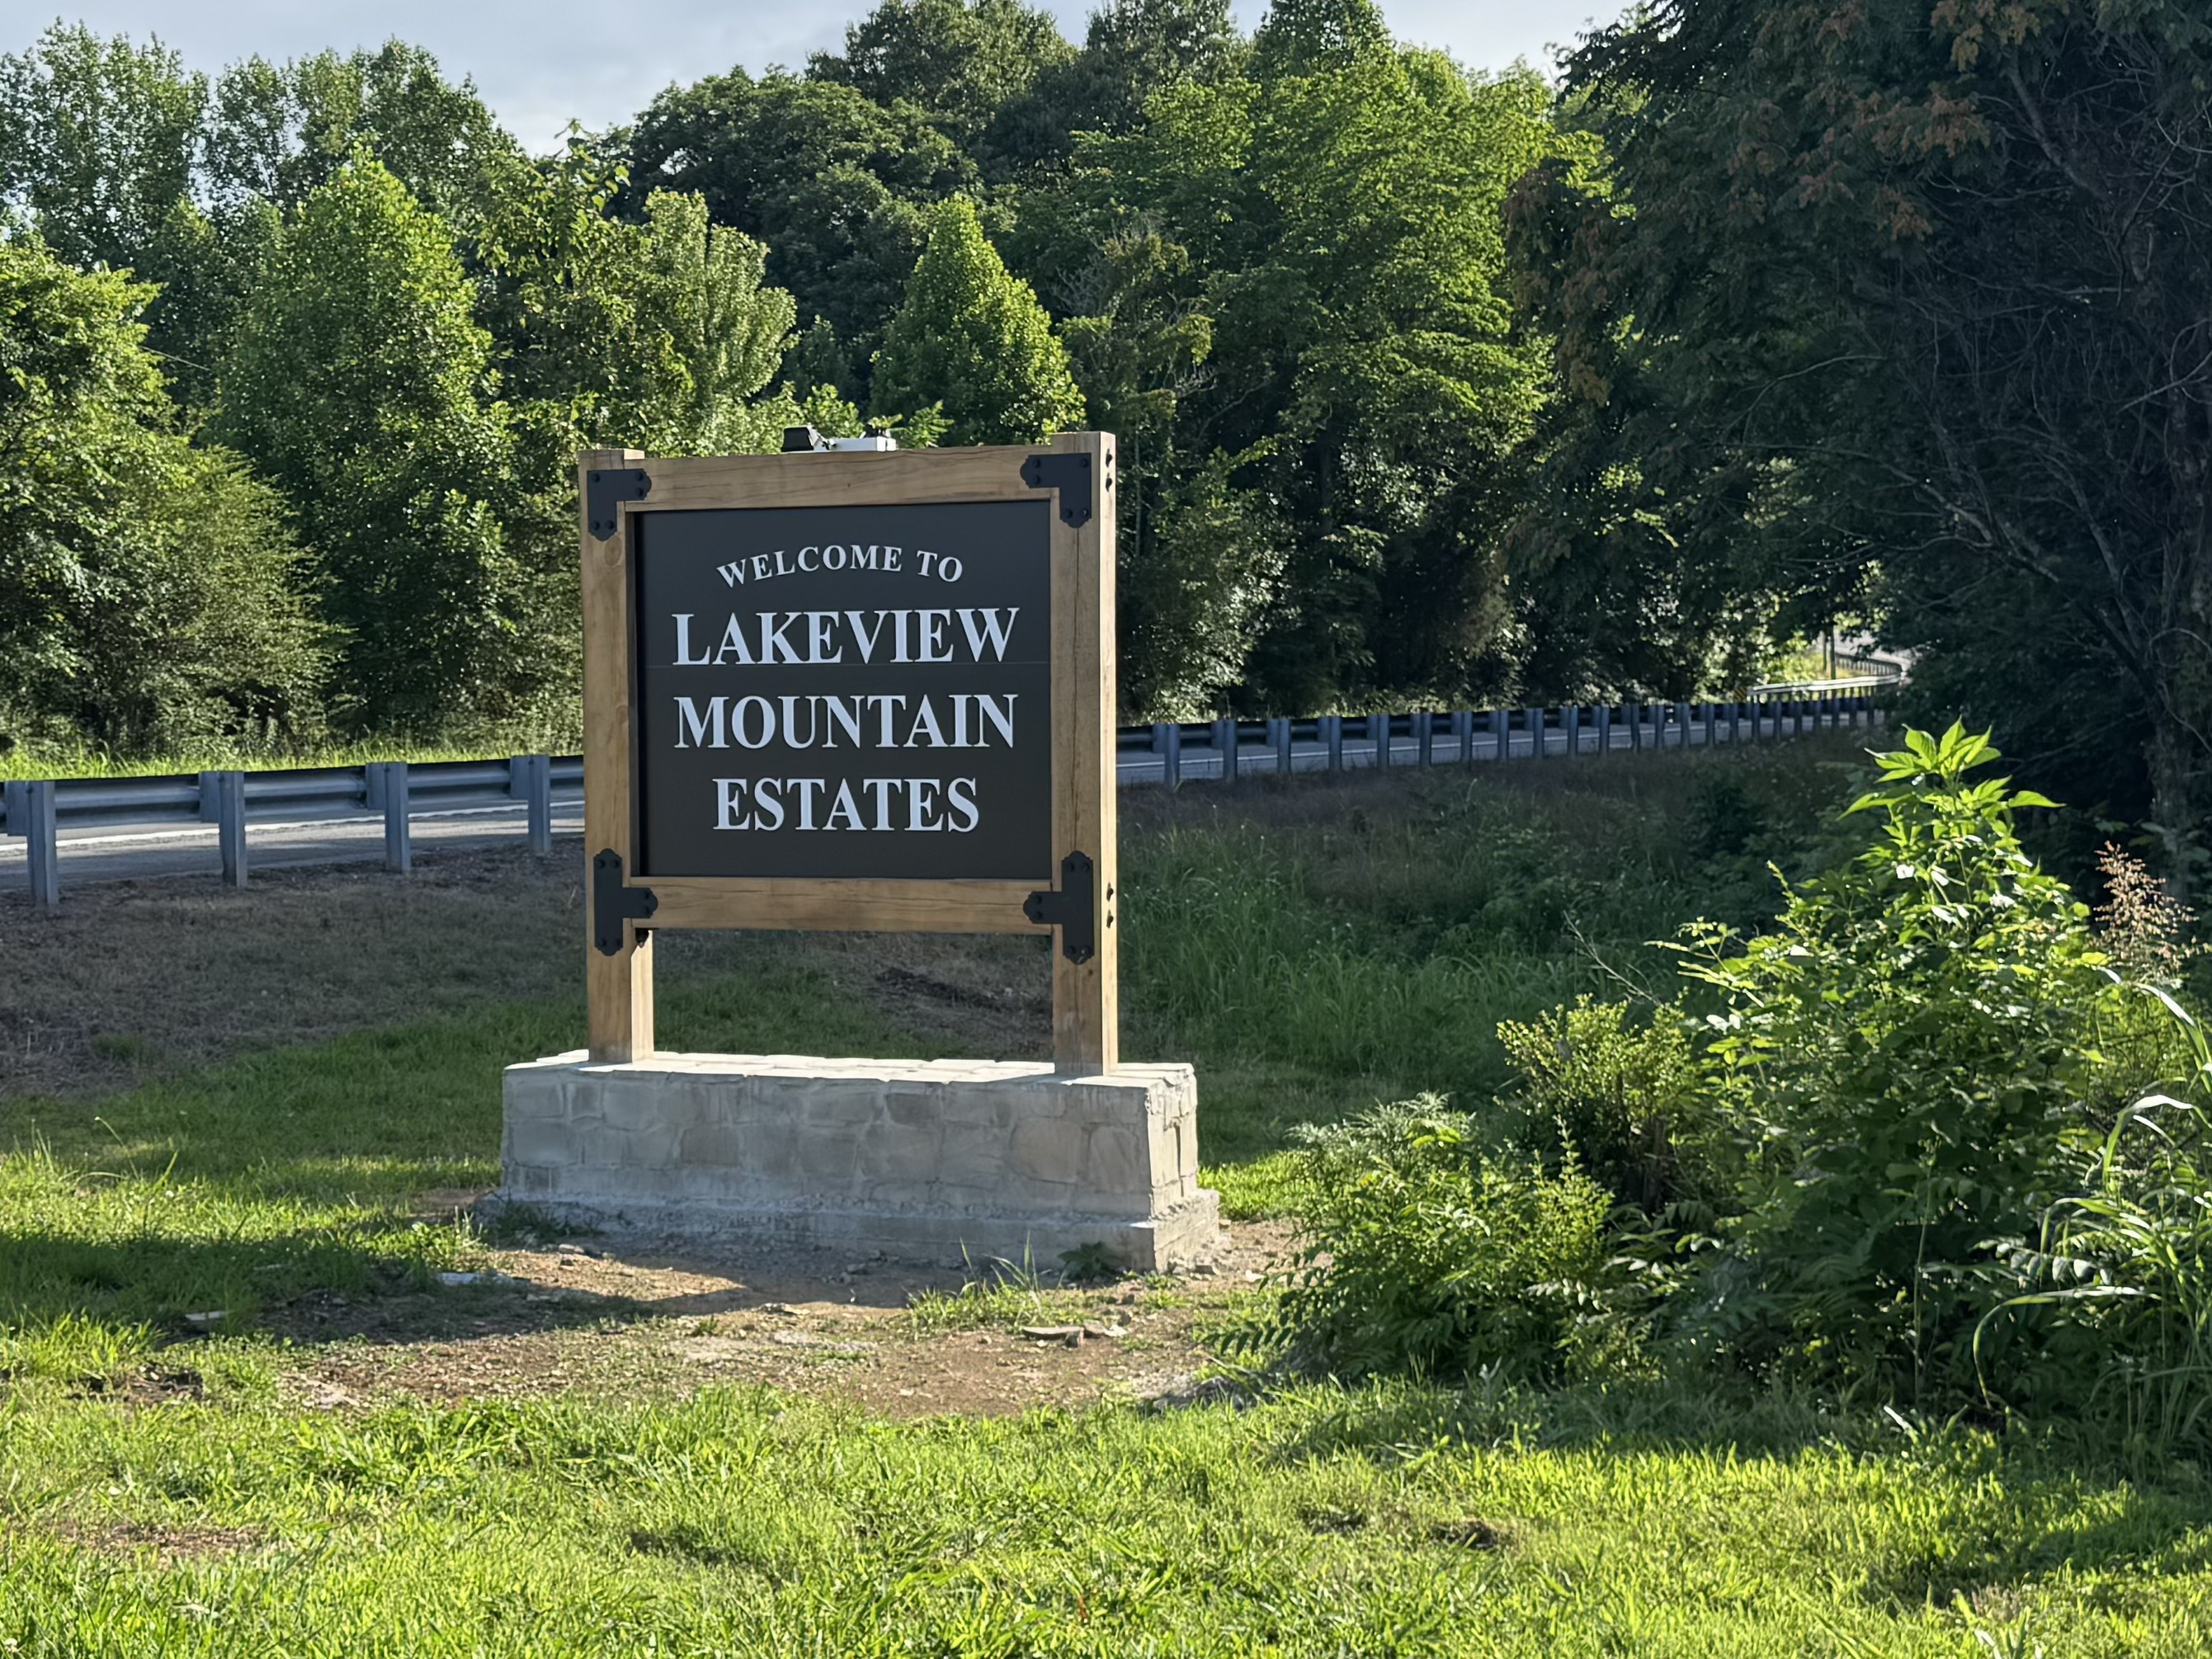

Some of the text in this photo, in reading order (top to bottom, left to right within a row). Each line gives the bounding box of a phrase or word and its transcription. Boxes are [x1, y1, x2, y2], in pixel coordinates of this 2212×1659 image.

[716, 544, 964, 587] WELCOME TO
[672, 607, 1020, 666] LAKEVIEW
[673, 694, 1018, 749] MOUNTAIN
[713, 778, 979, 832] ESTATES
